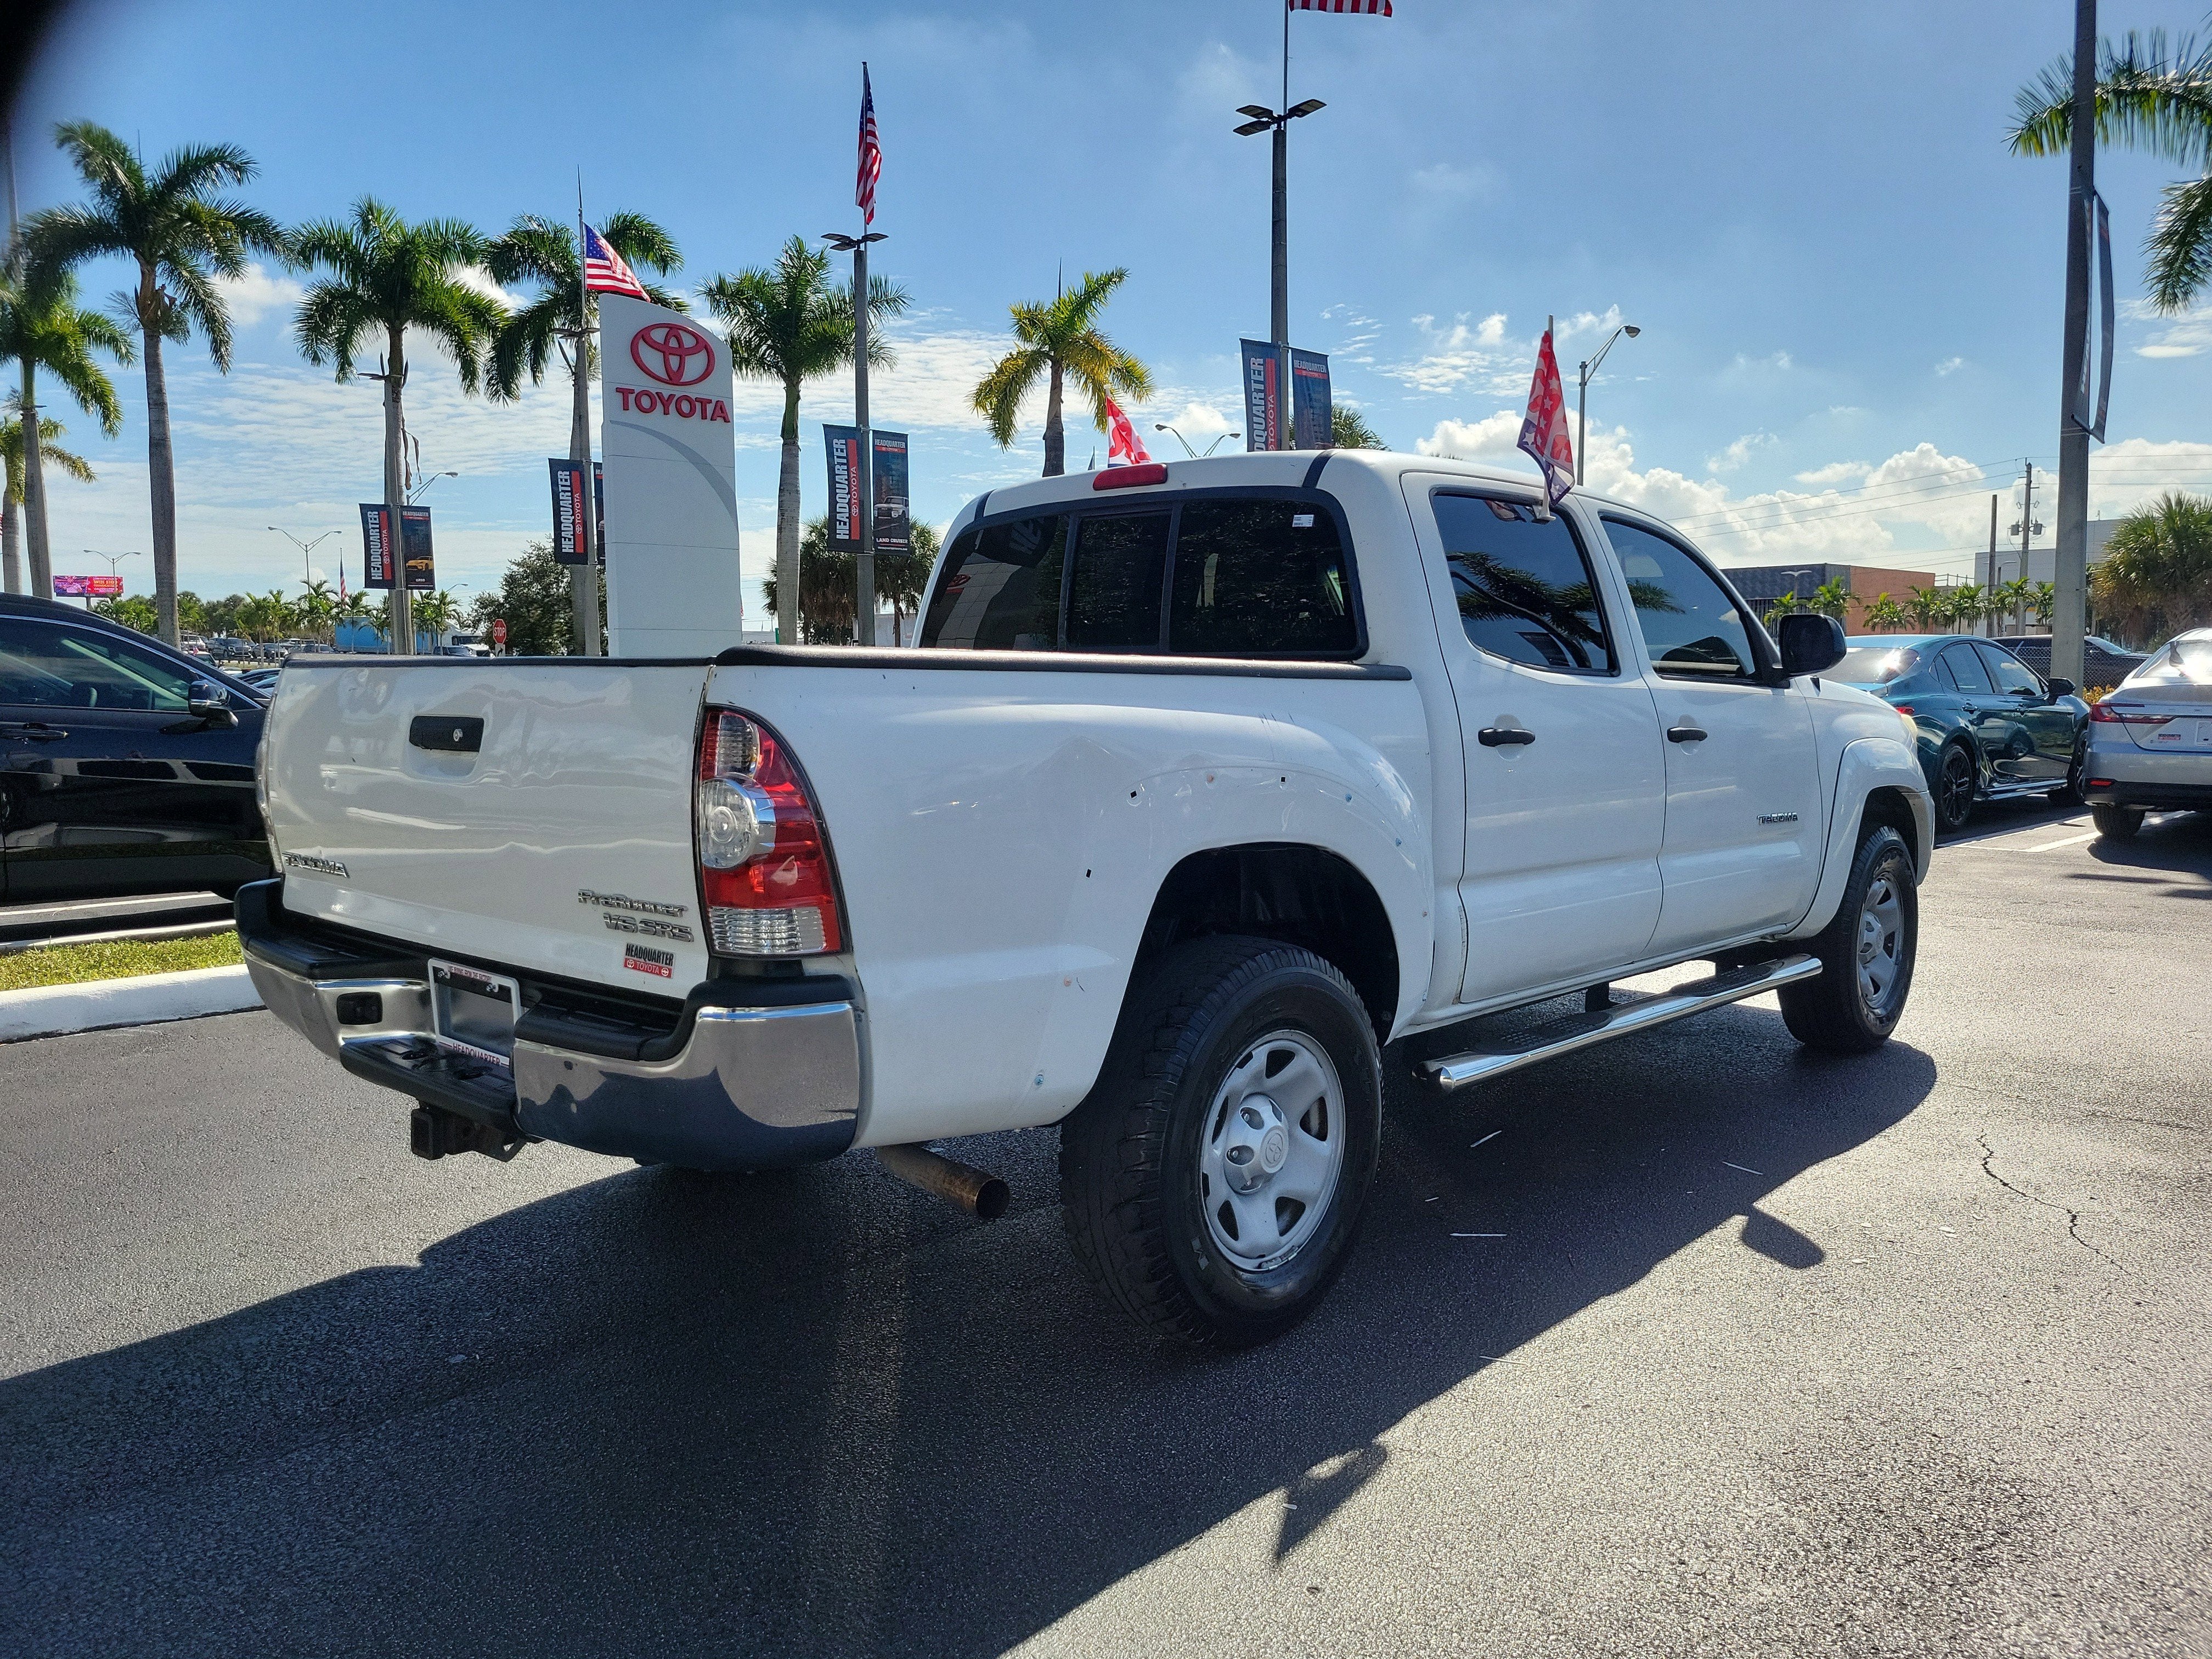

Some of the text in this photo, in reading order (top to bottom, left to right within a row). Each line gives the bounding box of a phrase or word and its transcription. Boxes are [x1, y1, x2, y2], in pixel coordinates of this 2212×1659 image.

[1294, 359, 1327, 373] HEADQUARTER
[616, 387, 730, 422] TOYOTA
[874, 438, 906, 449] HEADQUARTER
[833, 438, 850, 539] HEADQUARTER
[558, 470, 574, 553] HEADQUARTER
[367, 511, 383, 580] HEADQUARTER
[494, 627, 505, 636] STOP
[578, 889, 689, 918] PreRunner
[638, 918, 695, 943] SR5
[625, 943, 674, 967] HEADQUARTER
[636, 962, 659, 974] TOYOTA
